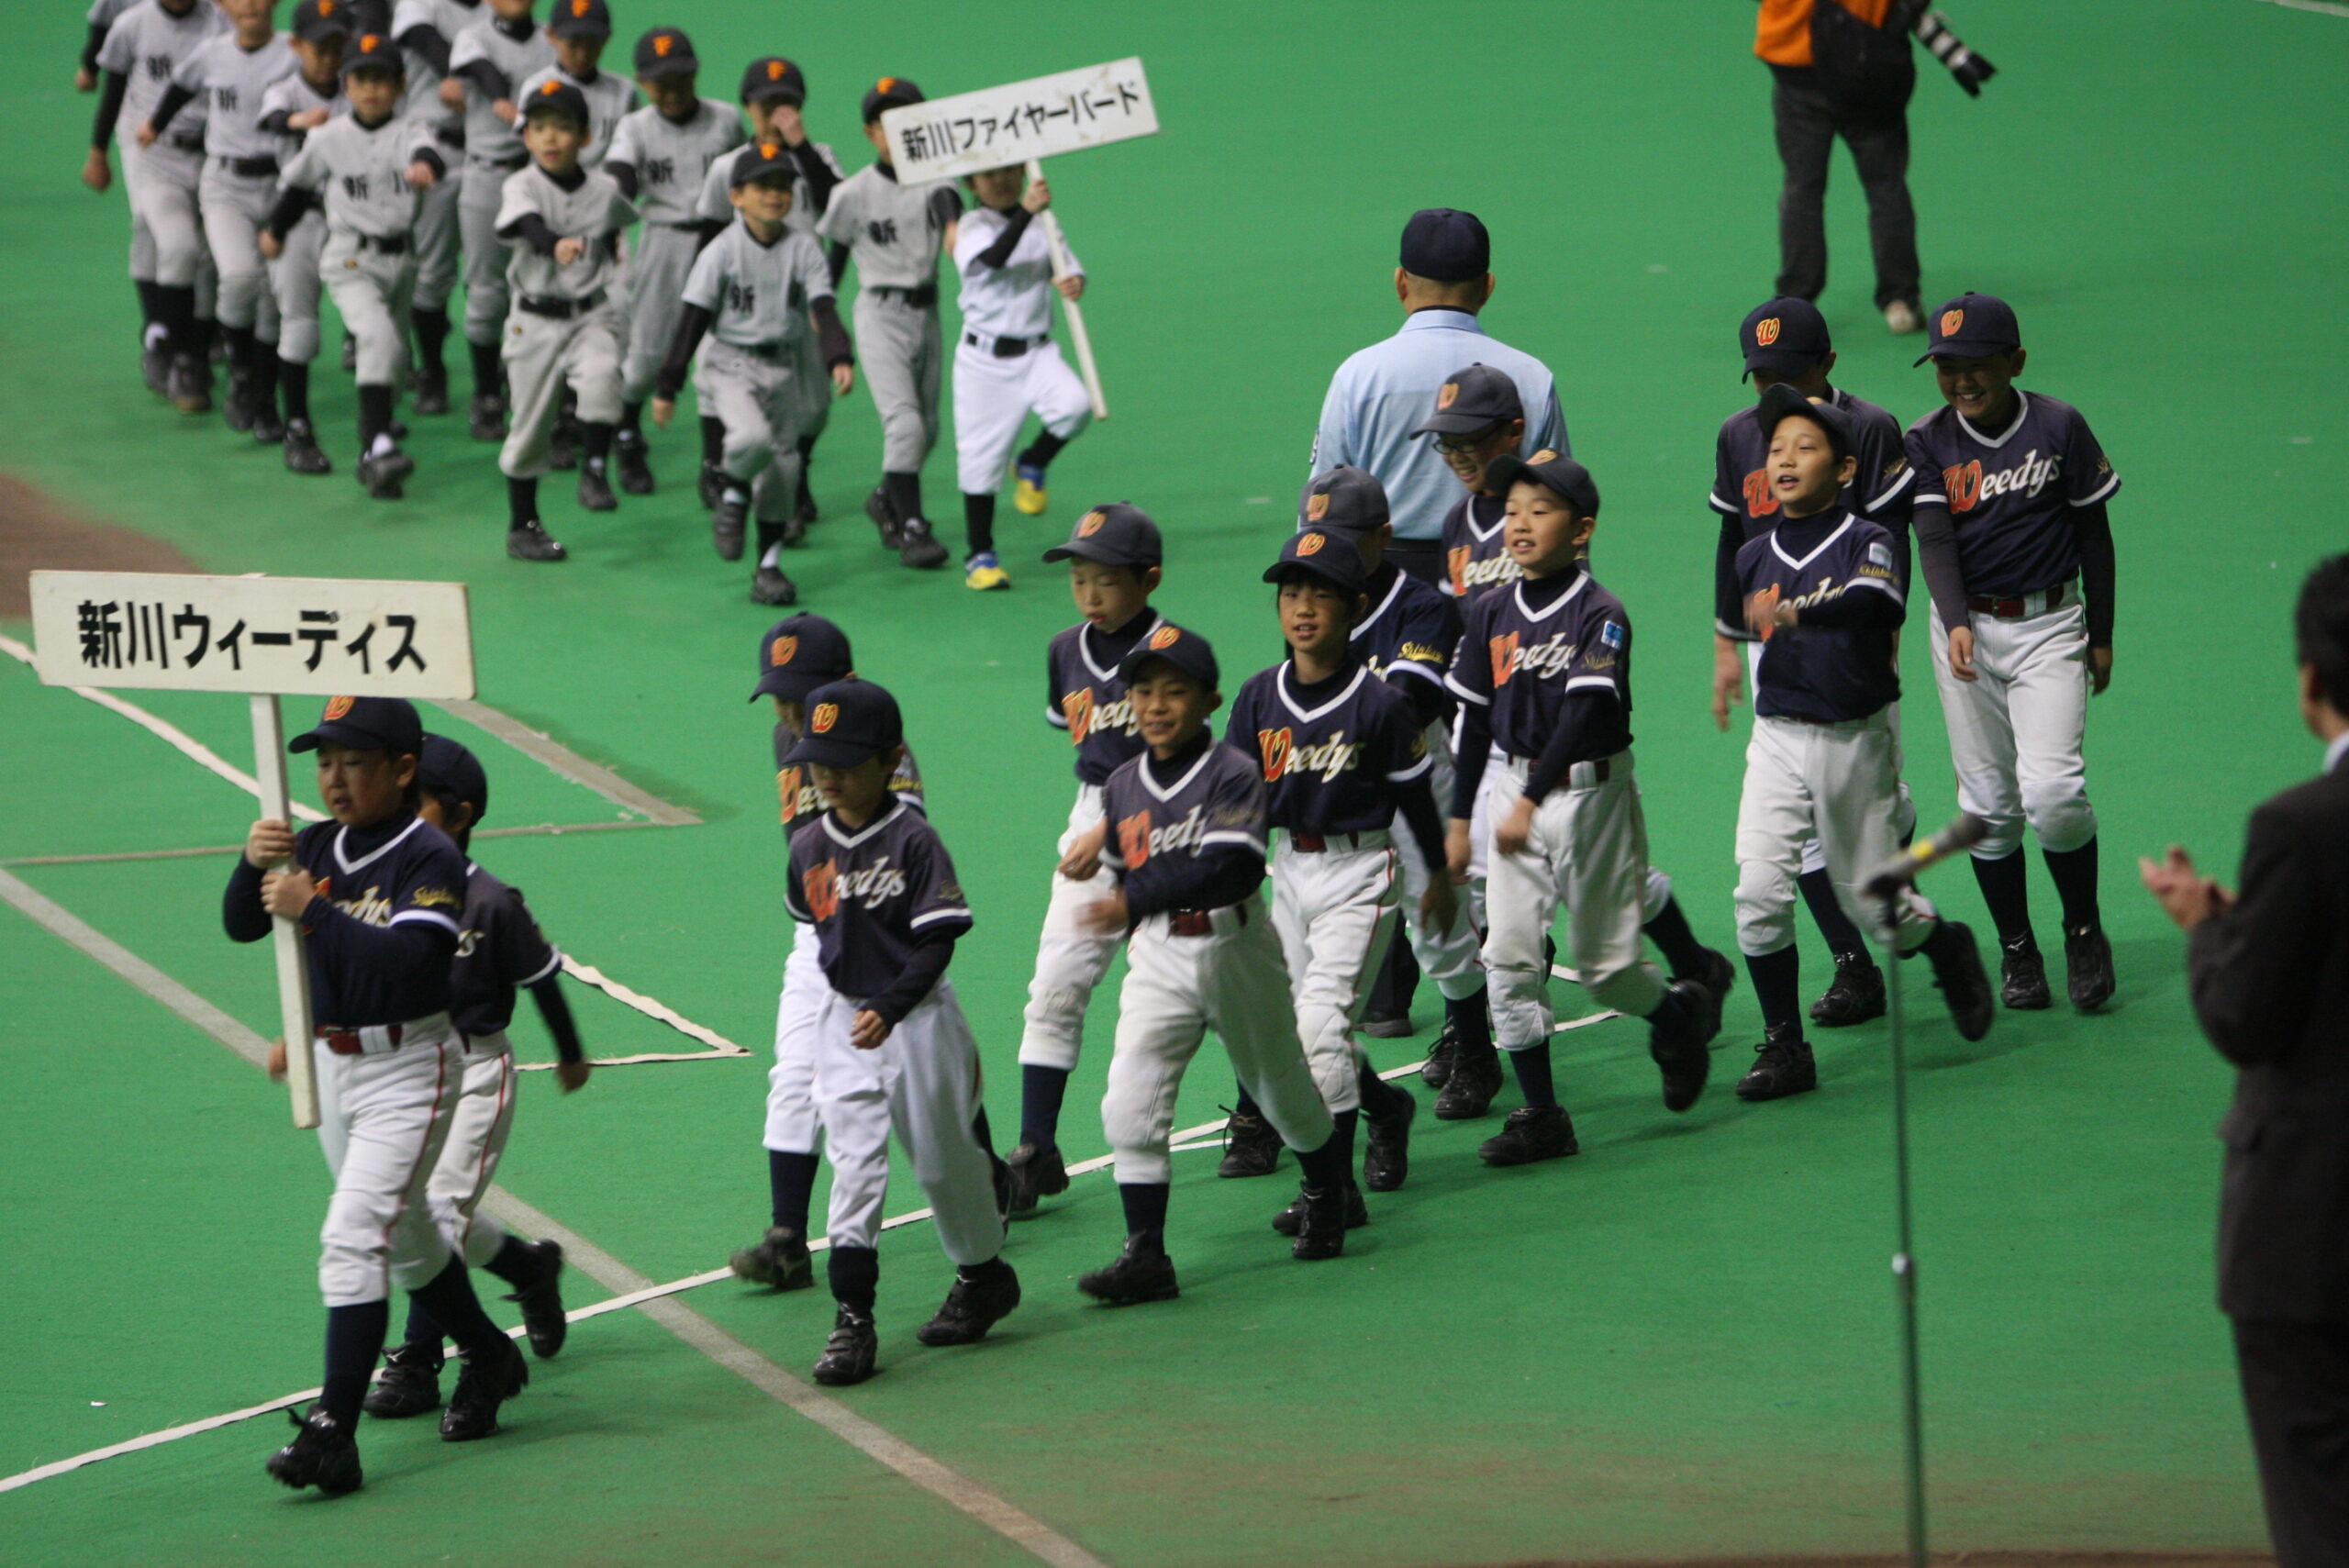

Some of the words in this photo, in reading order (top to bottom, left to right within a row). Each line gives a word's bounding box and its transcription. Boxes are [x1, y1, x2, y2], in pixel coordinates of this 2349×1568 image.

[900, 81, 1140, 163] 新川ファイヤーバード
[1756, 317, 1780, 346] W
[1942, 449, 2063, 514] Weedys
[77, 600, 427, 674] 新川ウィーディス
[1257, 727, 1366, 784] Weedys
[1117, 804, 1208, 870] Weedy
